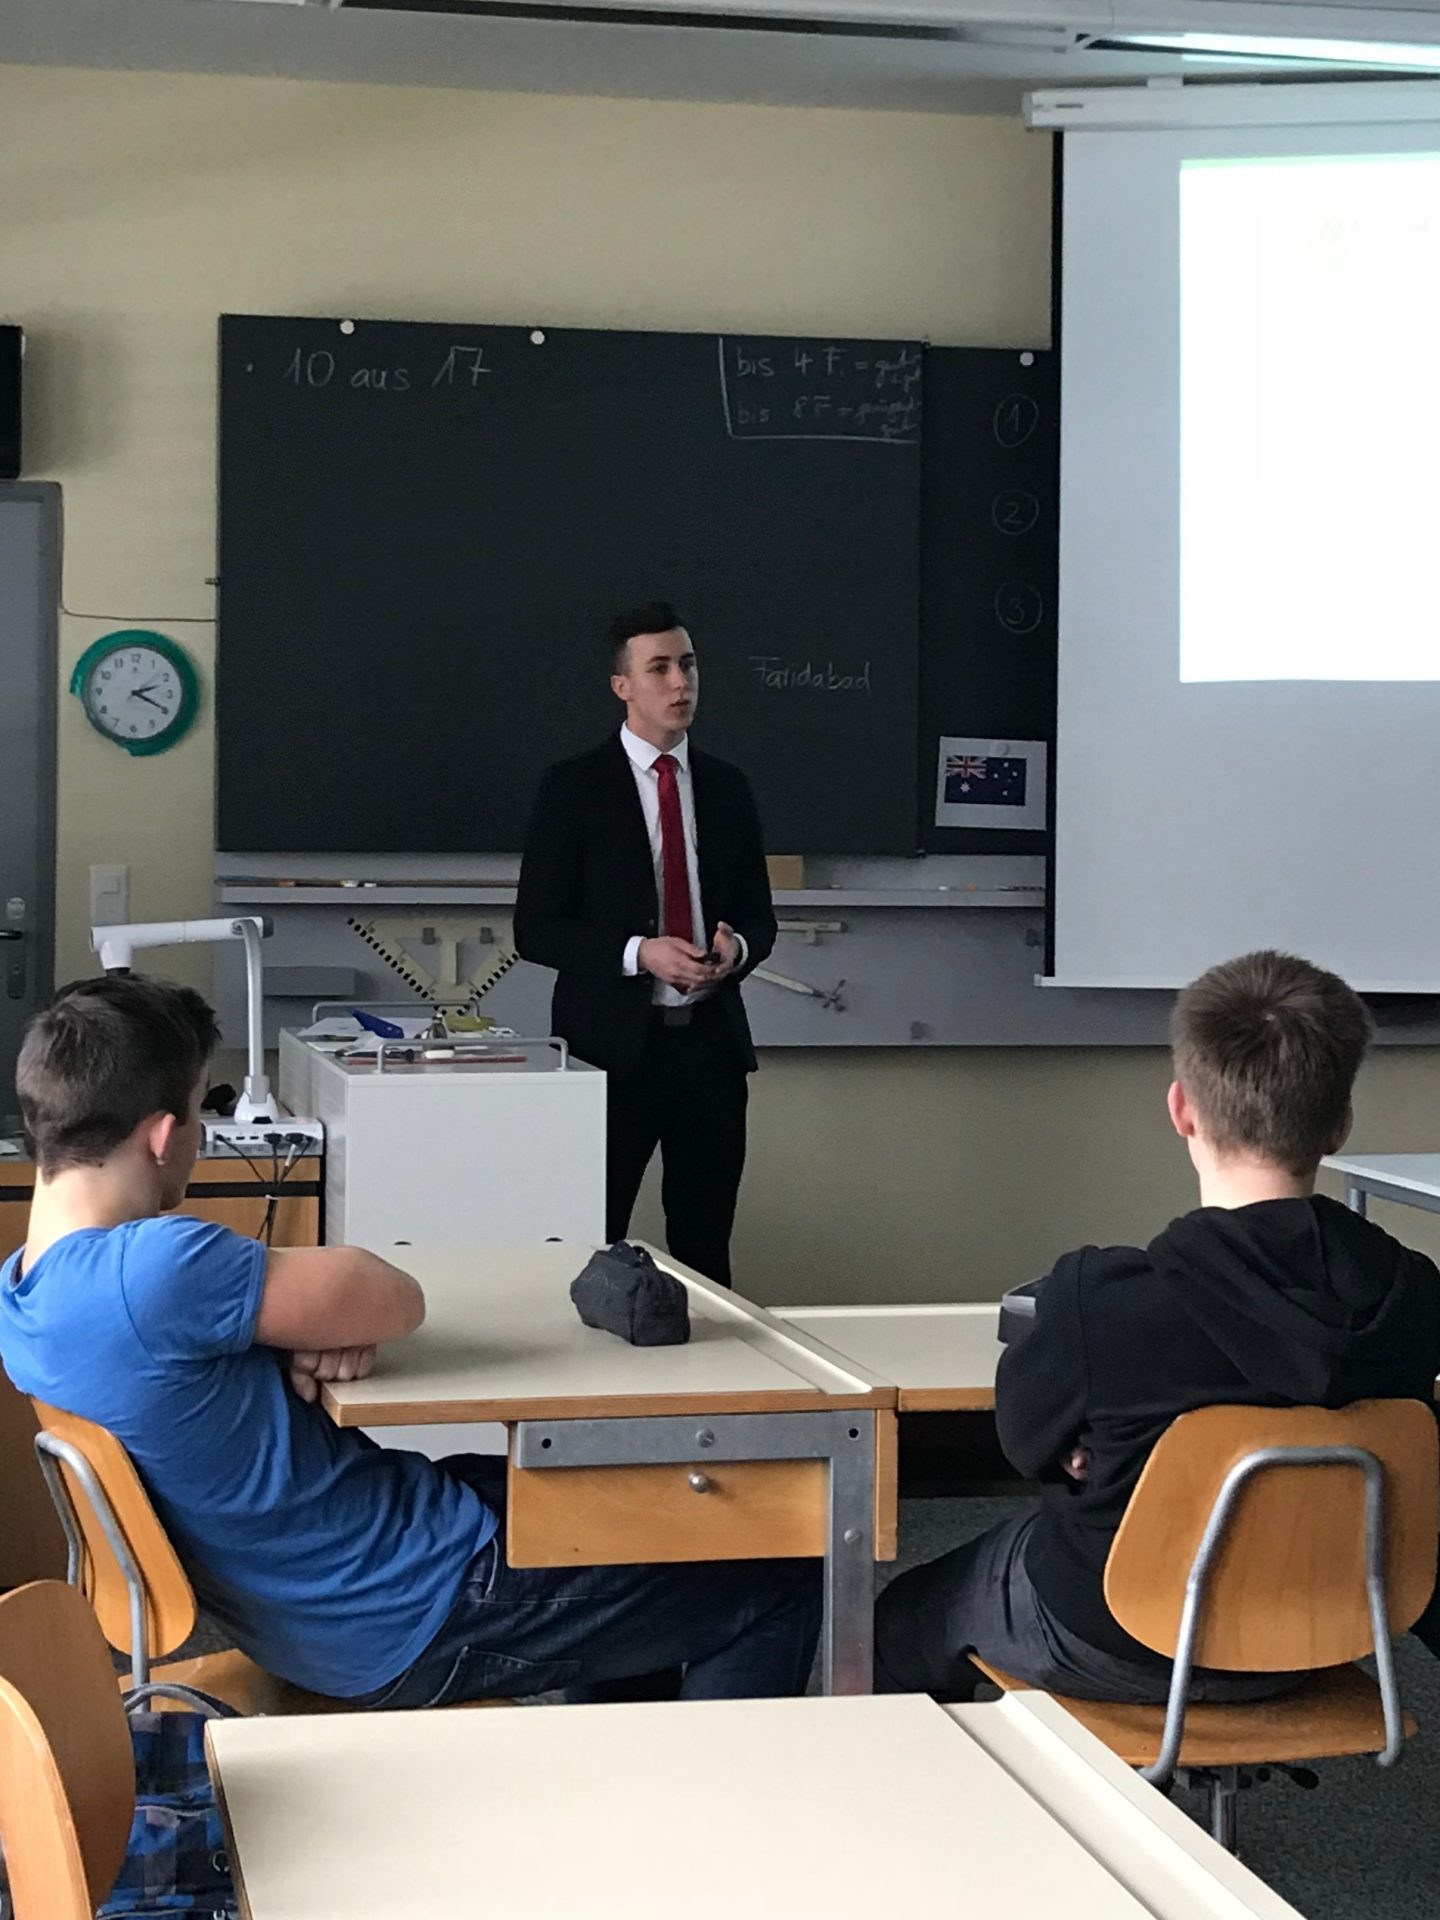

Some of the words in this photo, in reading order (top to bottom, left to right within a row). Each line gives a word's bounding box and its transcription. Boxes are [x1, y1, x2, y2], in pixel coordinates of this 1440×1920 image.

[283, 348, 335, 387] 10
[351, 368, 411, 390] aus
[431, 345, 492, 387] 17
[737, 346, 775, 377] bis
[736, 402, 771, 425] bis
